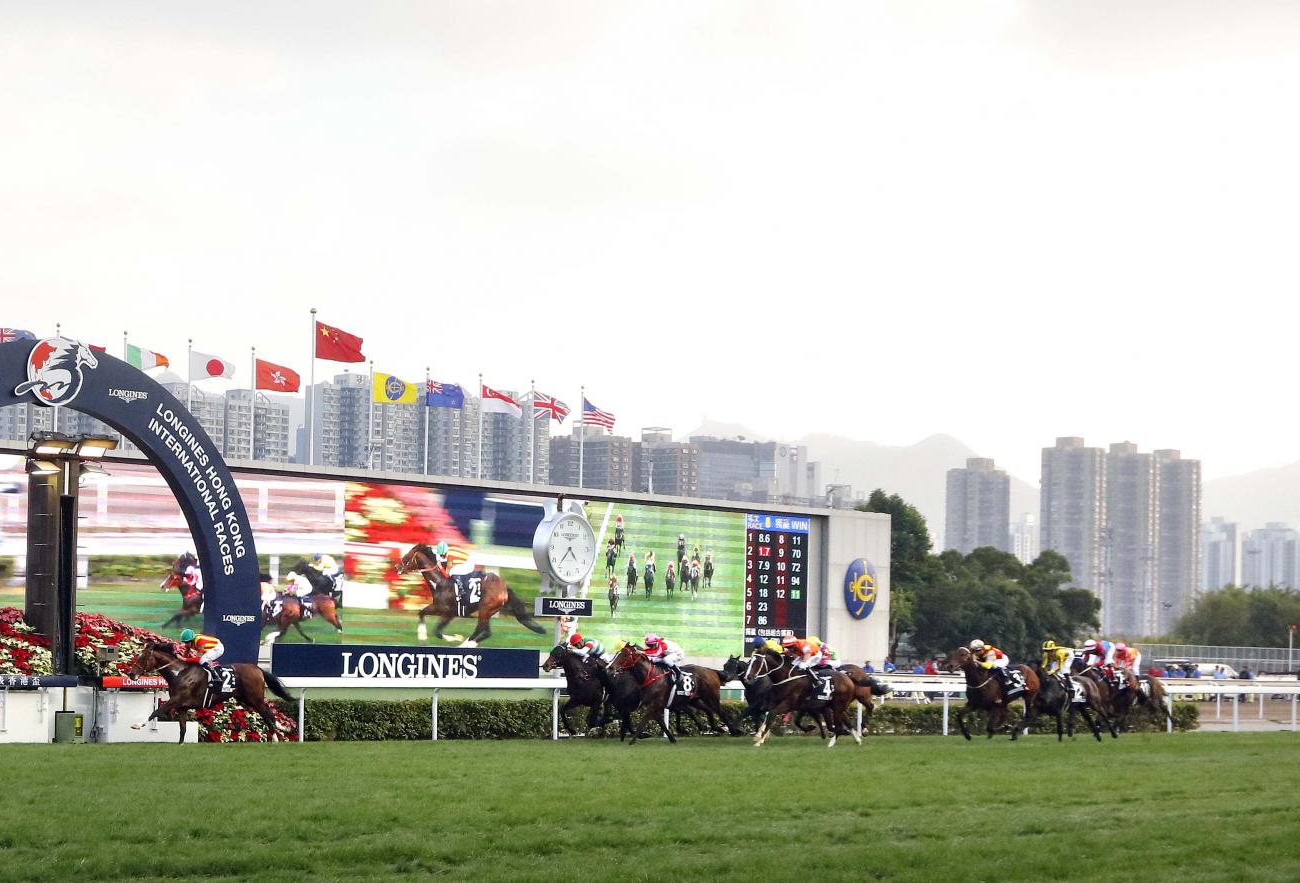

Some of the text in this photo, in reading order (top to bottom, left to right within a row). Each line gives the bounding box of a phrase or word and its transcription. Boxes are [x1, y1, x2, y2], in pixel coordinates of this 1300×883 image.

[108, 388, 148, 399] LONGINES
[156, 403, 246, 558] LONGINES HONG KONG
[148, 418, 234, 576] INTERNATIONAL RACES
[792, 521, 808, 530] WIN
[549, 600, 585, 609] LONGINES
[222, 614, 255, 622] LONGINES
[122, 678, 158, 686] LONGINES
[222, 671, 231, 688] 2
[683, 675, 692, 691] 8
